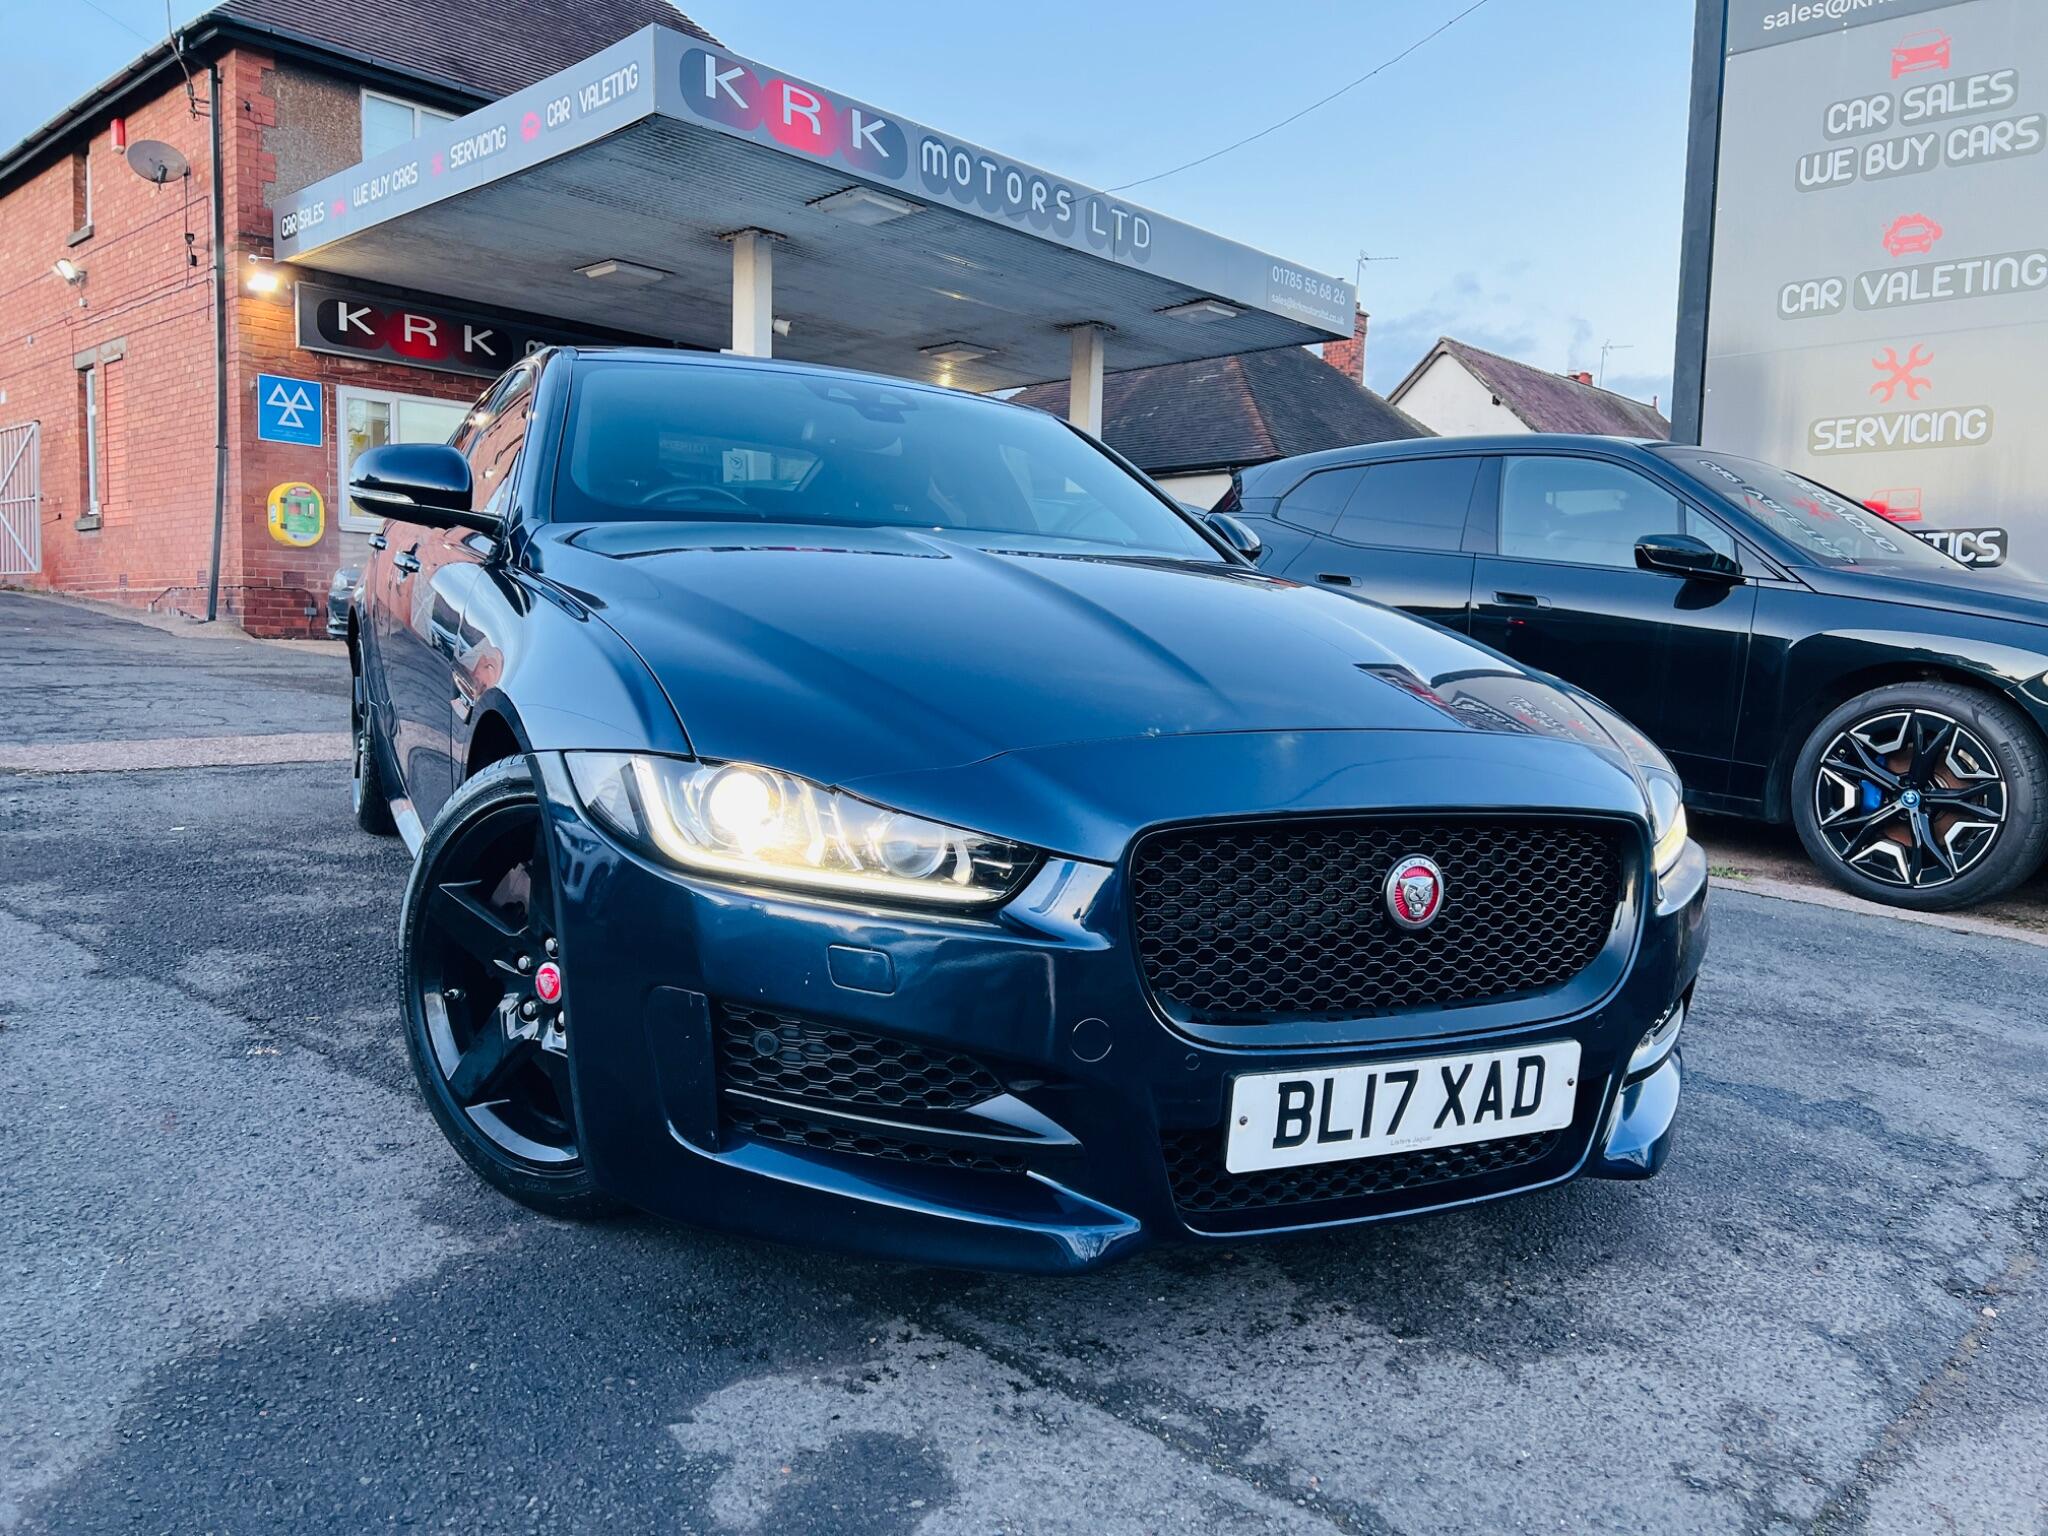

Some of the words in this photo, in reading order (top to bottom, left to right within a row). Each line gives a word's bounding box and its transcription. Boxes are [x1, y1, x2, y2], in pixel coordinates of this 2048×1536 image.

[547, 97, 571, 128] CAR
[579, 62, 639, 113] VALETING
[1827, 95, 1890, 134] CAR
[1903, 70, 2014, 121] SALES
[450, 126, 507, 169] SERVICING
[1799, 148, 1855, 186] WE
[1865, 134, 1935, 176] BUY
[1947, 115, 2040, 161] CARS
[353, 185, 369, 207] WE
[371, 176, 390, 200] BUY
[393, 161, 418, 192] CARS
[921, 139, 1073, 222] MOTORS
[1091, 200, 1151, 251] LTD
[281, 213, 297, 236] CAR
[299, 201, 324, 230] SALES
[1272, 265, 1302, 290] 01785
[1305, 277, 1317, 295] 55
[1320, 283, 1331, 301] 68
[1334, 287, 1345, 306] 26
[1781, 279, 1843, 314] CAR
[1861, 253, 2048, 305] VALETING
[1814, 408, 1987, 450] SERVICING
[1914, 530, 2001, 562] TICS
[1272, 1069, 1420, 1149] BL17
[1433, 1054, 1546, 1130] XAD
